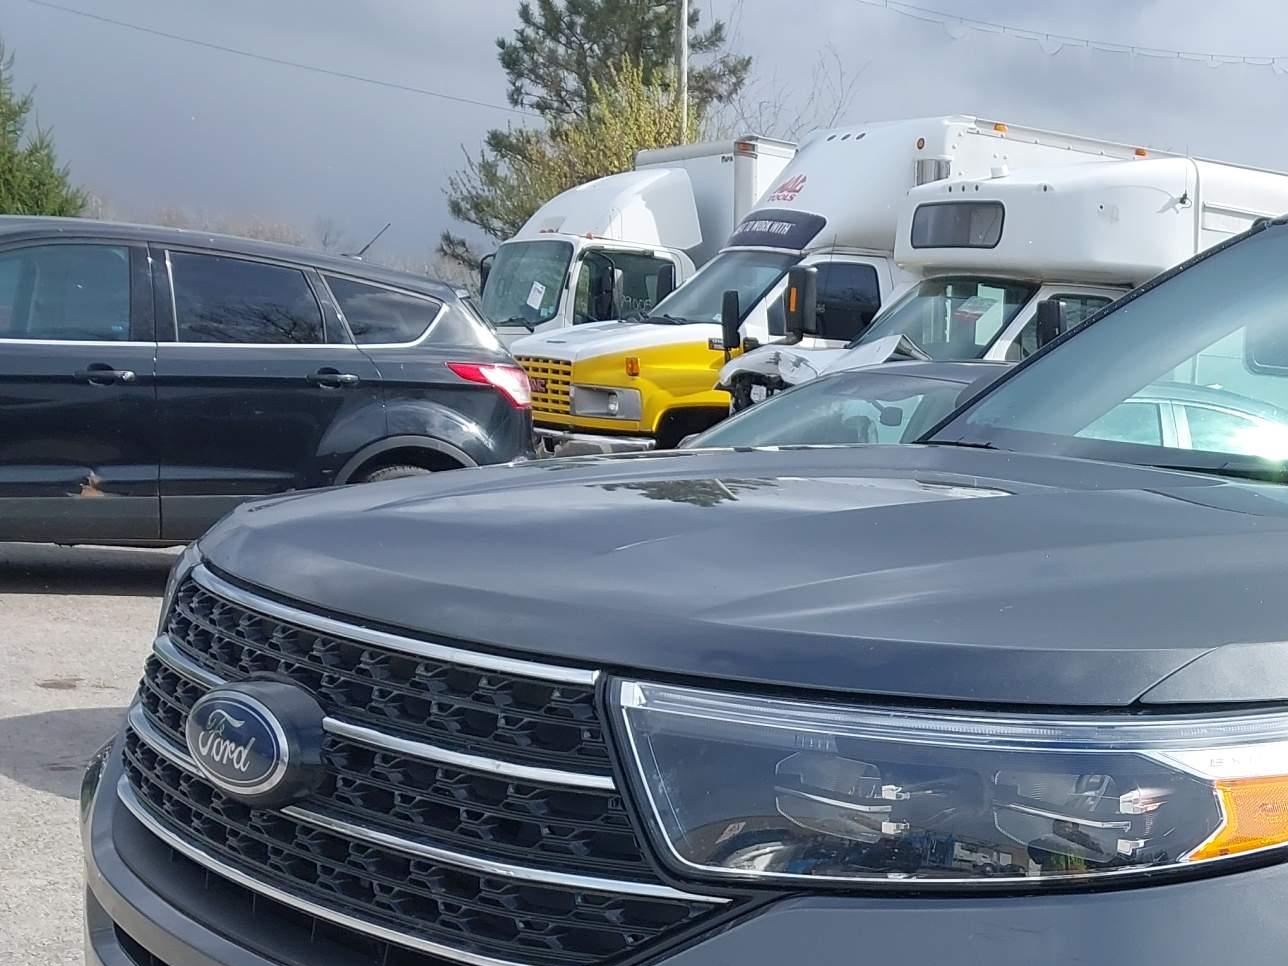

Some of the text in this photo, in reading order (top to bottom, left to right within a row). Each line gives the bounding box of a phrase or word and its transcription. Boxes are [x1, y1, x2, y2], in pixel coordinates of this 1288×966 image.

[773, 174, 807, 193] MAG
[767, 193, 797, 202] TOOLS
[769, 221, 792, 235] WITH
[198, 708, 257, 773] Ford
